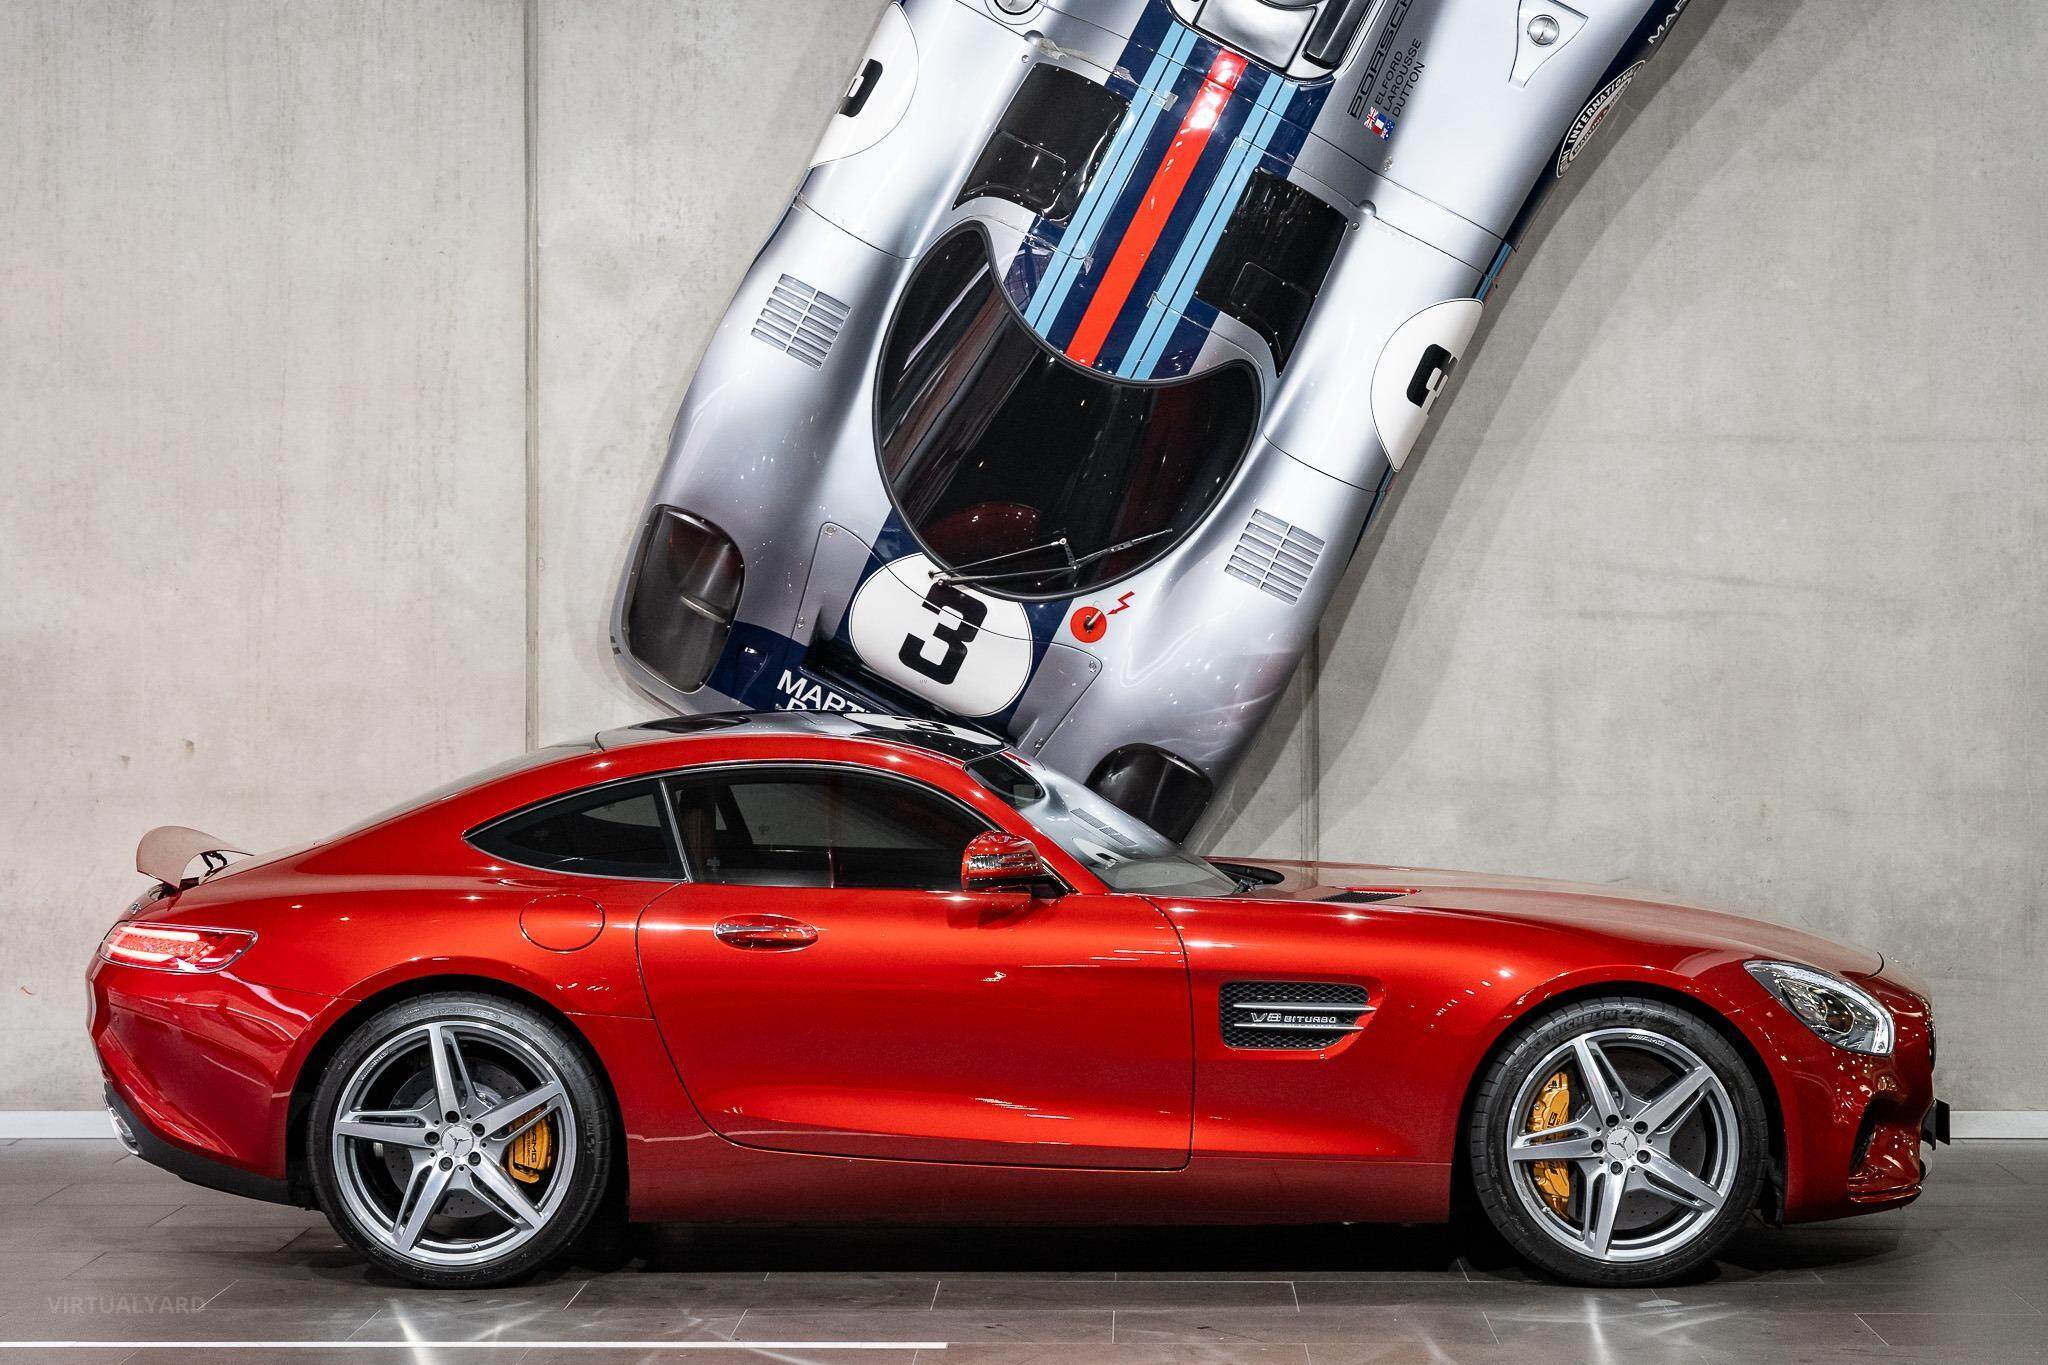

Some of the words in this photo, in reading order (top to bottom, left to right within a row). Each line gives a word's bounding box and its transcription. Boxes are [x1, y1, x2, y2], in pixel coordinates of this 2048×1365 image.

[1375, 51, 1403, 105] ELFORD
[1383, 38, 1422, 111] LAROUSSE
[1392, 61, 1425, 117] DUTTON
[899, 578, 988, 685] 3
[1250, 1012, 1281, 1022] V8
[1283, 1015, 1337, 1024] BITURBO
